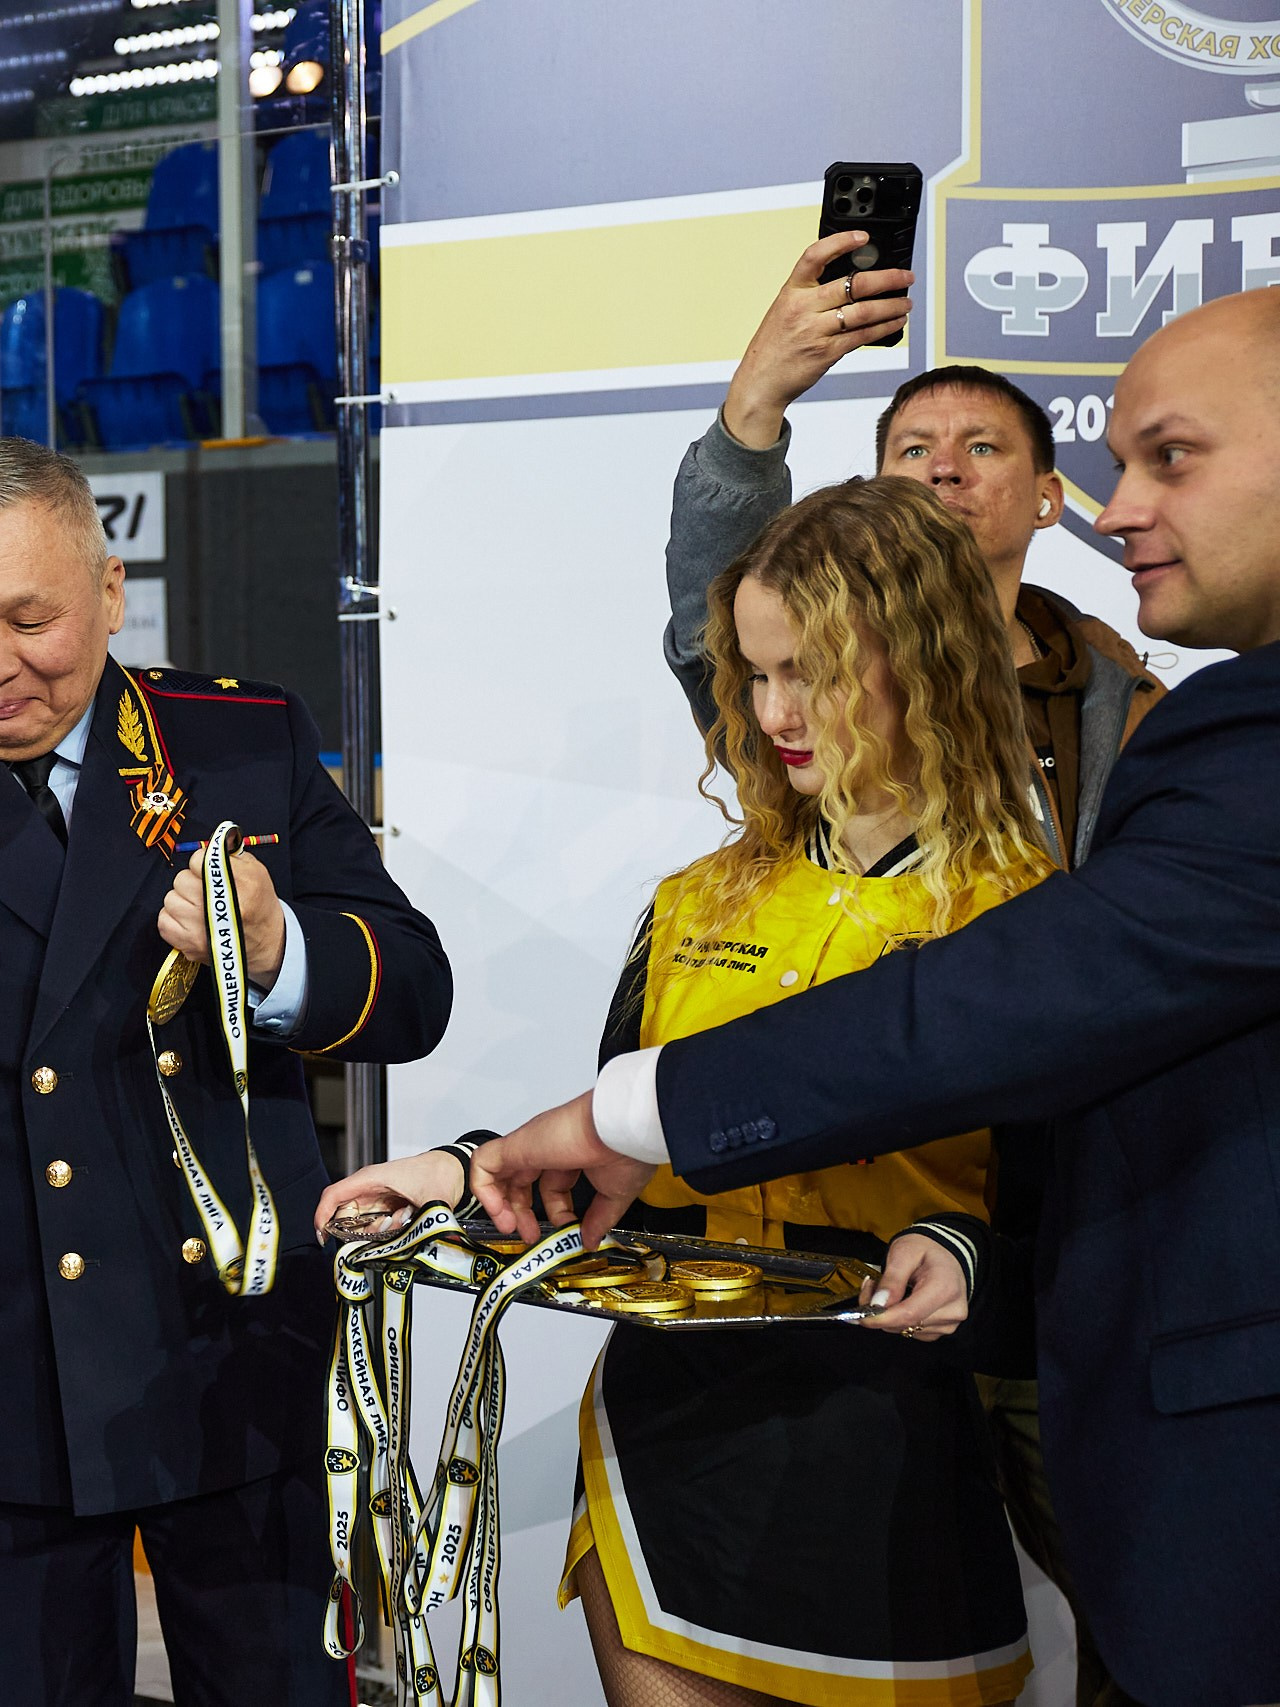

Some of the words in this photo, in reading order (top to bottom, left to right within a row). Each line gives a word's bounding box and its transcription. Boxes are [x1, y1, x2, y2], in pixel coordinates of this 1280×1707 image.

[1115, 0, 1241, 59] ЕРСКАЯ
[1048, 394, 1115, 443] 20
[208, 825, 229, 922] ХОККЕЙНАЯ
[218, 927, 241, 1039] ОФИЦЕРСКАЯ
[511, 1231, 583, 1280] ЦЕРСКАЯ
[463, 1278, 508, 1383] ХОККЕЙНАЯ
[387, 1326, 400, 1450] ОФИЦЕРСКАЯ
[336, 1510, 349, 1550] 2025
[441, 1523, 462, 1566] 2025
[484, 1486, 496, 1613] ОФИЦЕРСКАЯ
